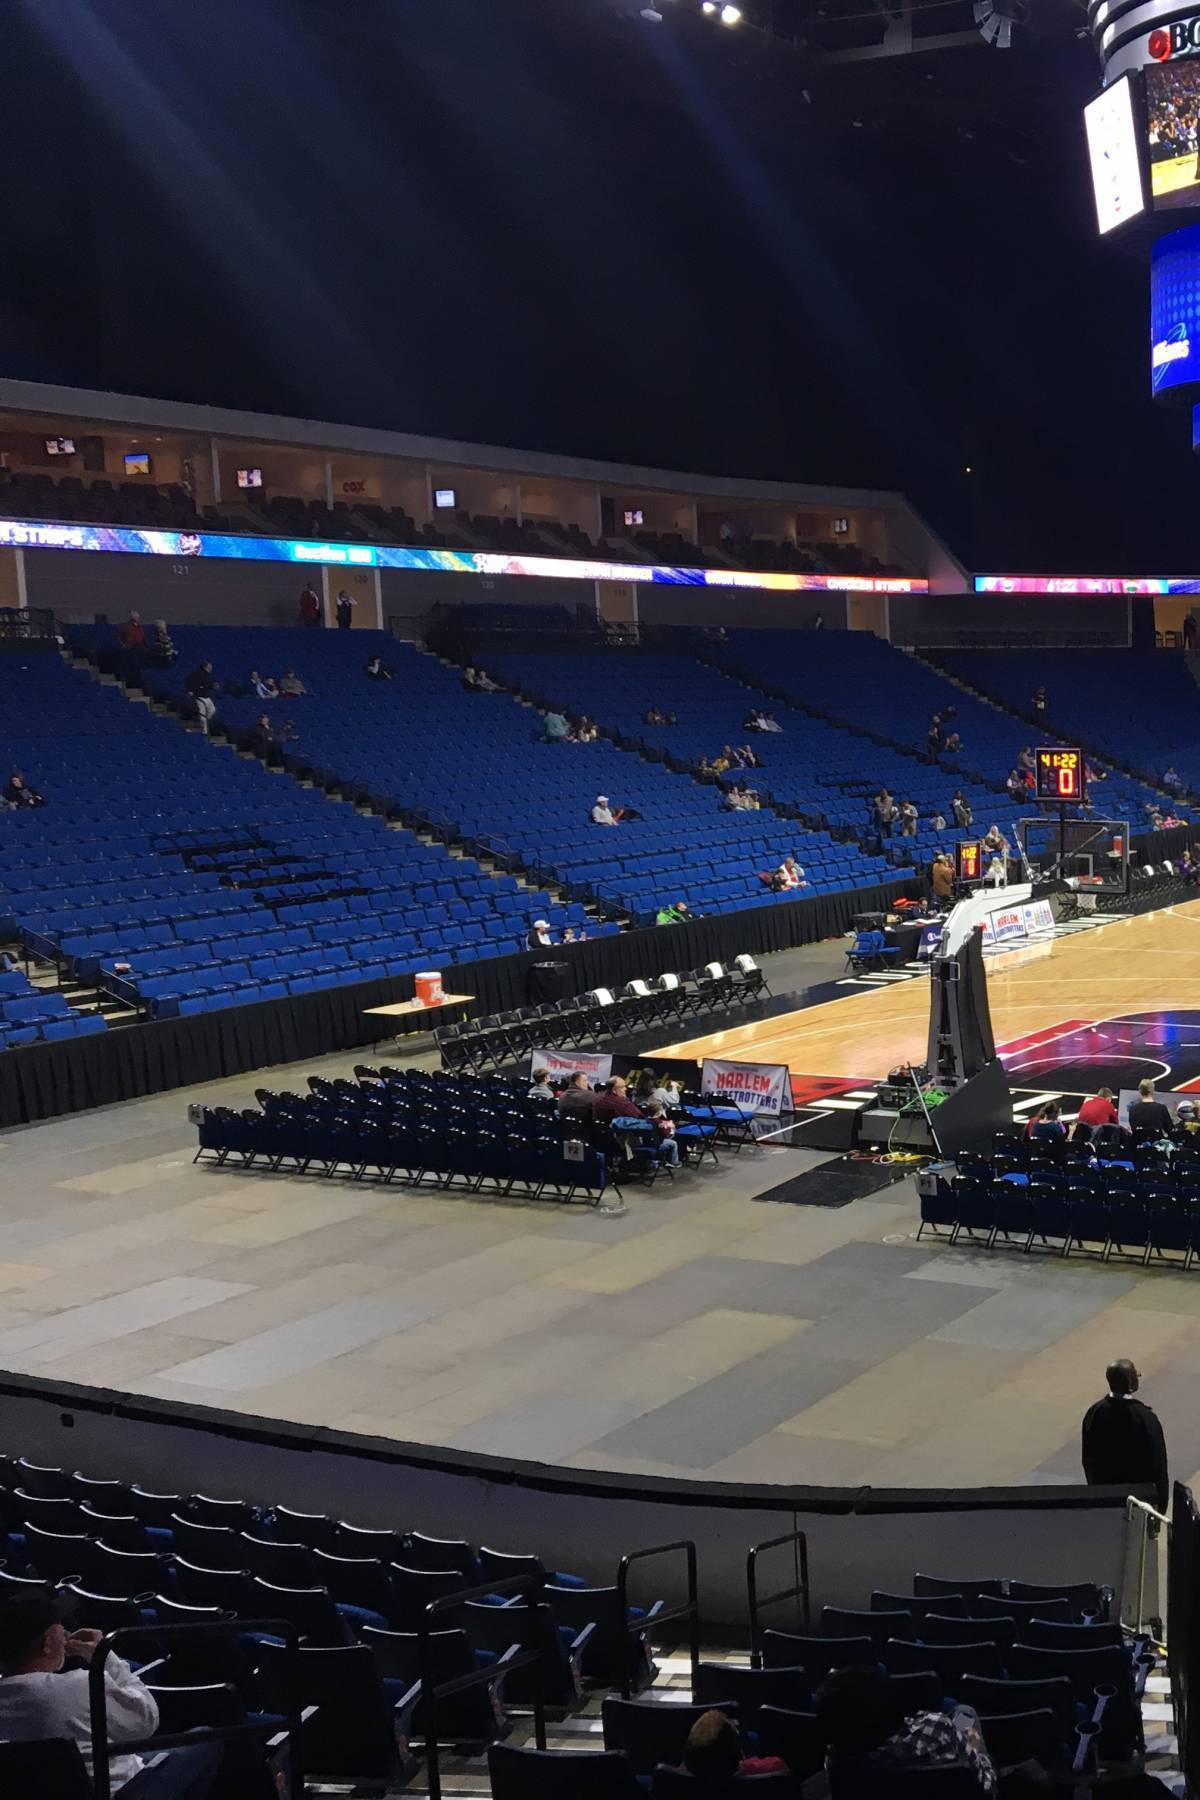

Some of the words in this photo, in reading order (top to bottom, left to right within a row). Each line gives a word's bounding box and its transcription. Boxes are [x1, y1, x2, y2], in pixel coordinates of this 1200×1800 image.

[1041, 753, 1077, 768] 41:22
[1059, 768, 1074, 794] 0
[997, 914, 1019, 928] HARLEM
[716, 1071, 771, 1094] HARLEM
